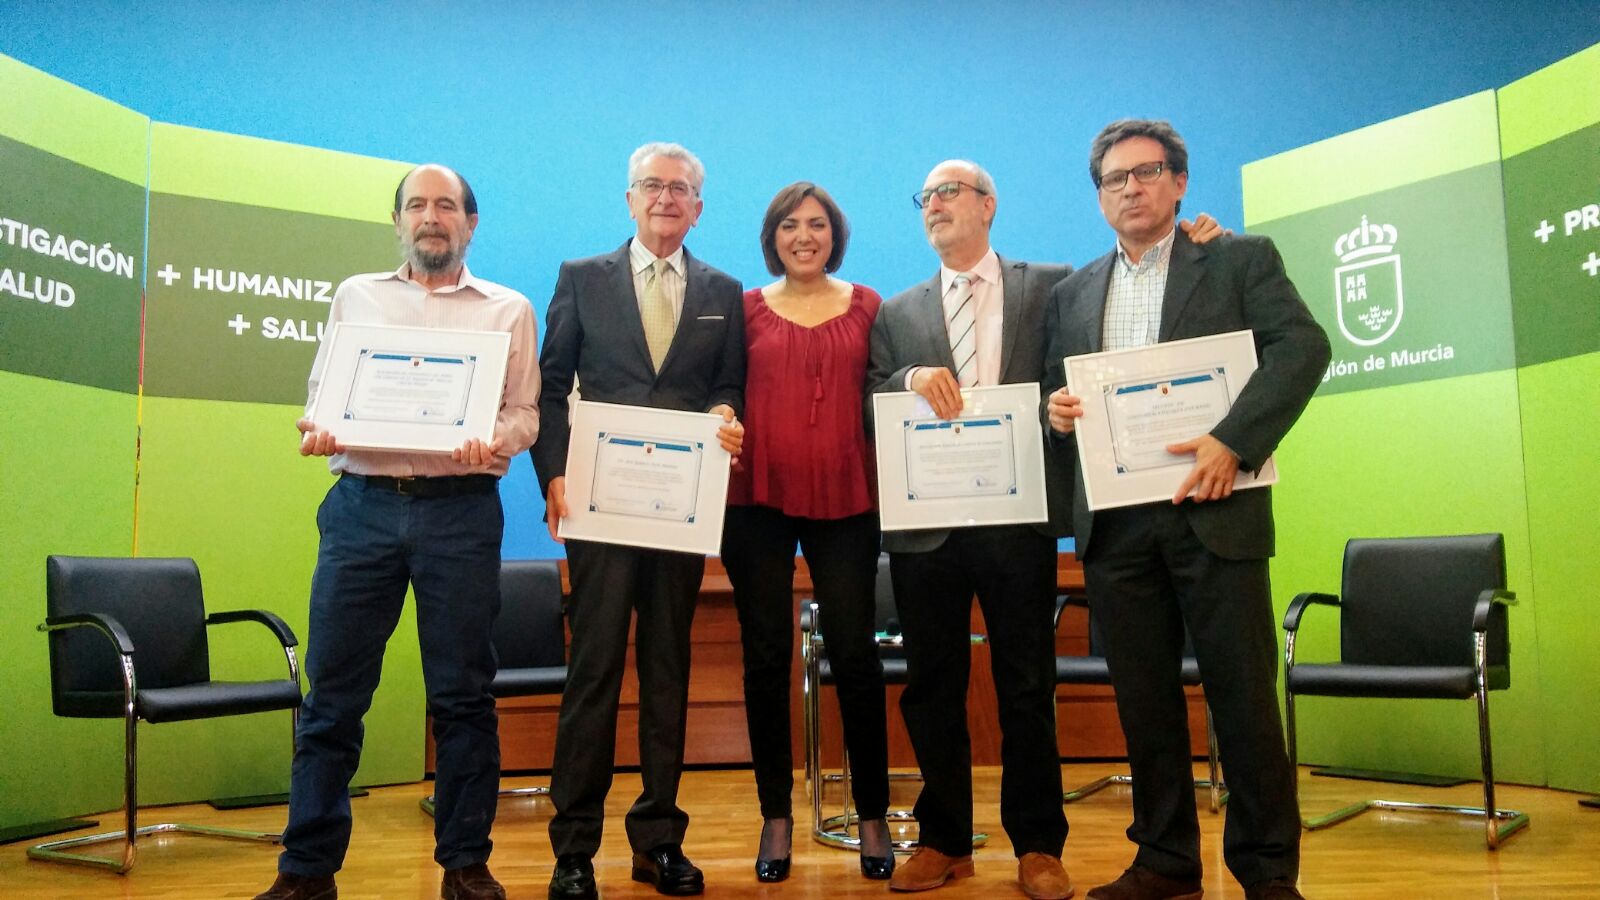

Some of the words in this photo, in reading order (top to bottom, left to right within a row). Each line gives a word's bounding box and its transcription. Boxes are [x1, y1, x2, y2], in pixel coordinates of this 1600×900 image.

[0, 216, 134, 279] TIGACIÓN
[0, 268, 76, 308] ALUD
[193, 267, 333, 303] HUMANIZ
[1363, 354, 1385, 372] de
[1391, 343, 1454, 368] Murcia
